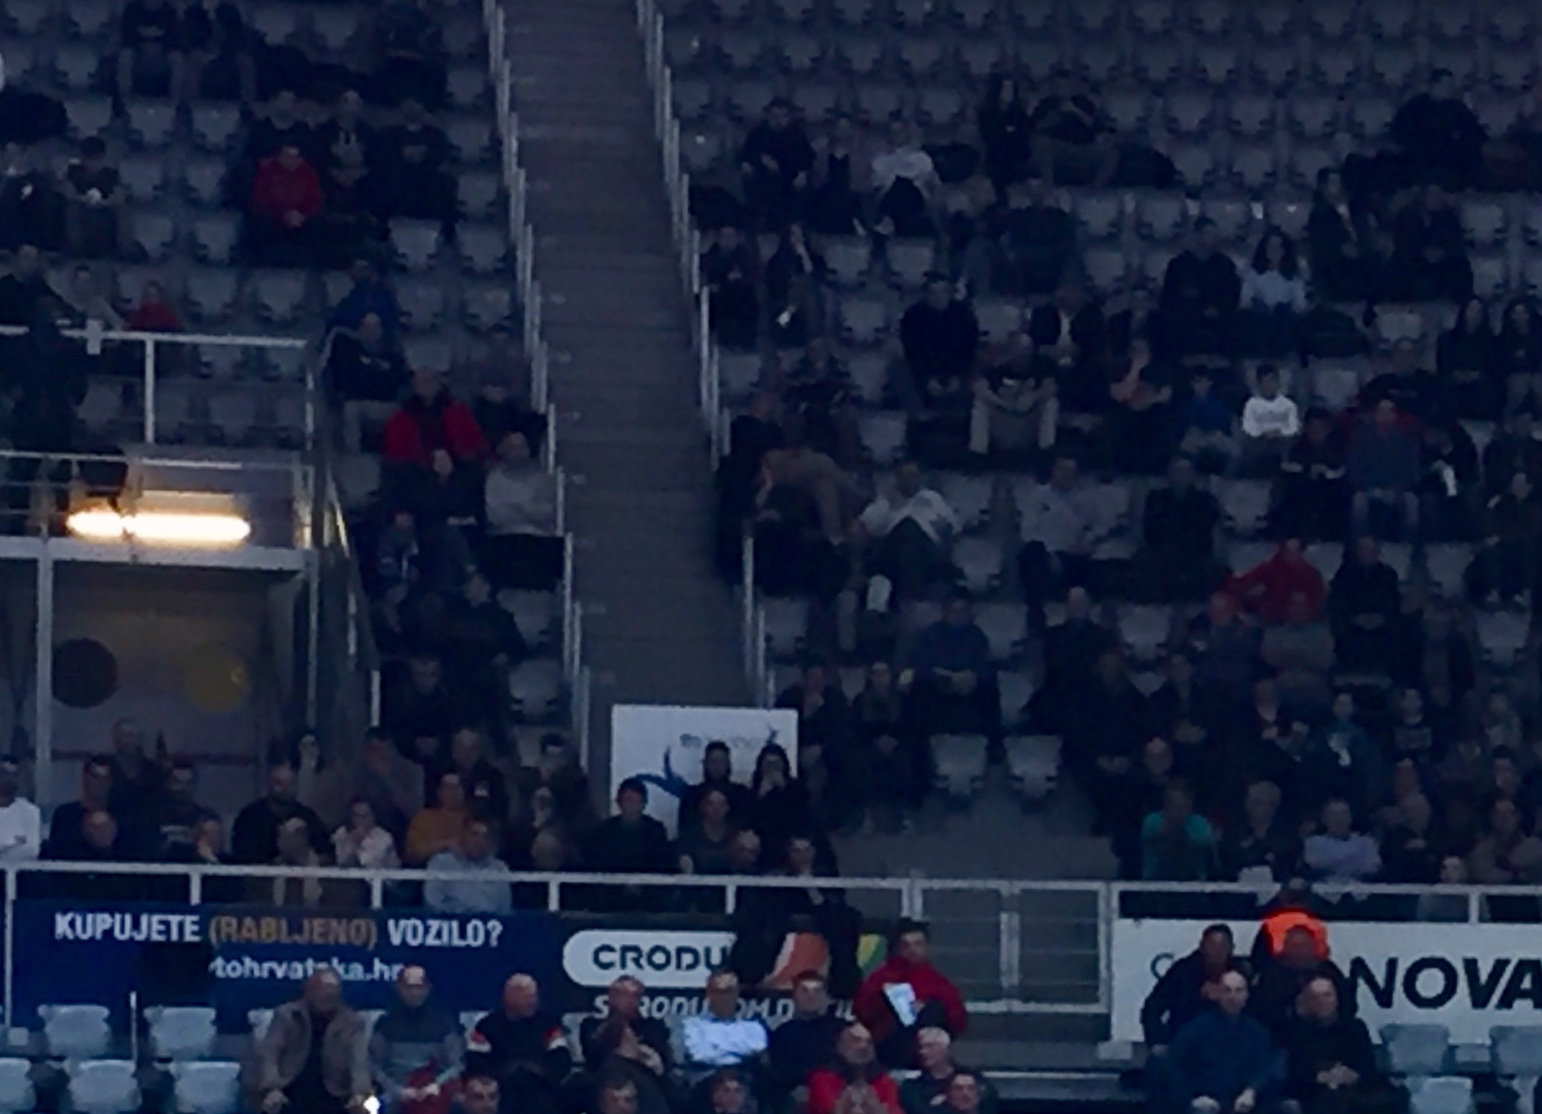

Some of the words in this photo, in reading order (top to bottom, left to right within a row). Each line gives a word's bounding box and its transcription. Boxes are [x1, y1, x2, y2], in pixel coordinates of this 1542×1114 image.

[54, 912, 201, 943] KUPUJETE
[208, 915, 379, 951] (RABLJENO)
[387, 917, 504, 948] VOZILO?
[593, 944, 736, 972] CRODU
